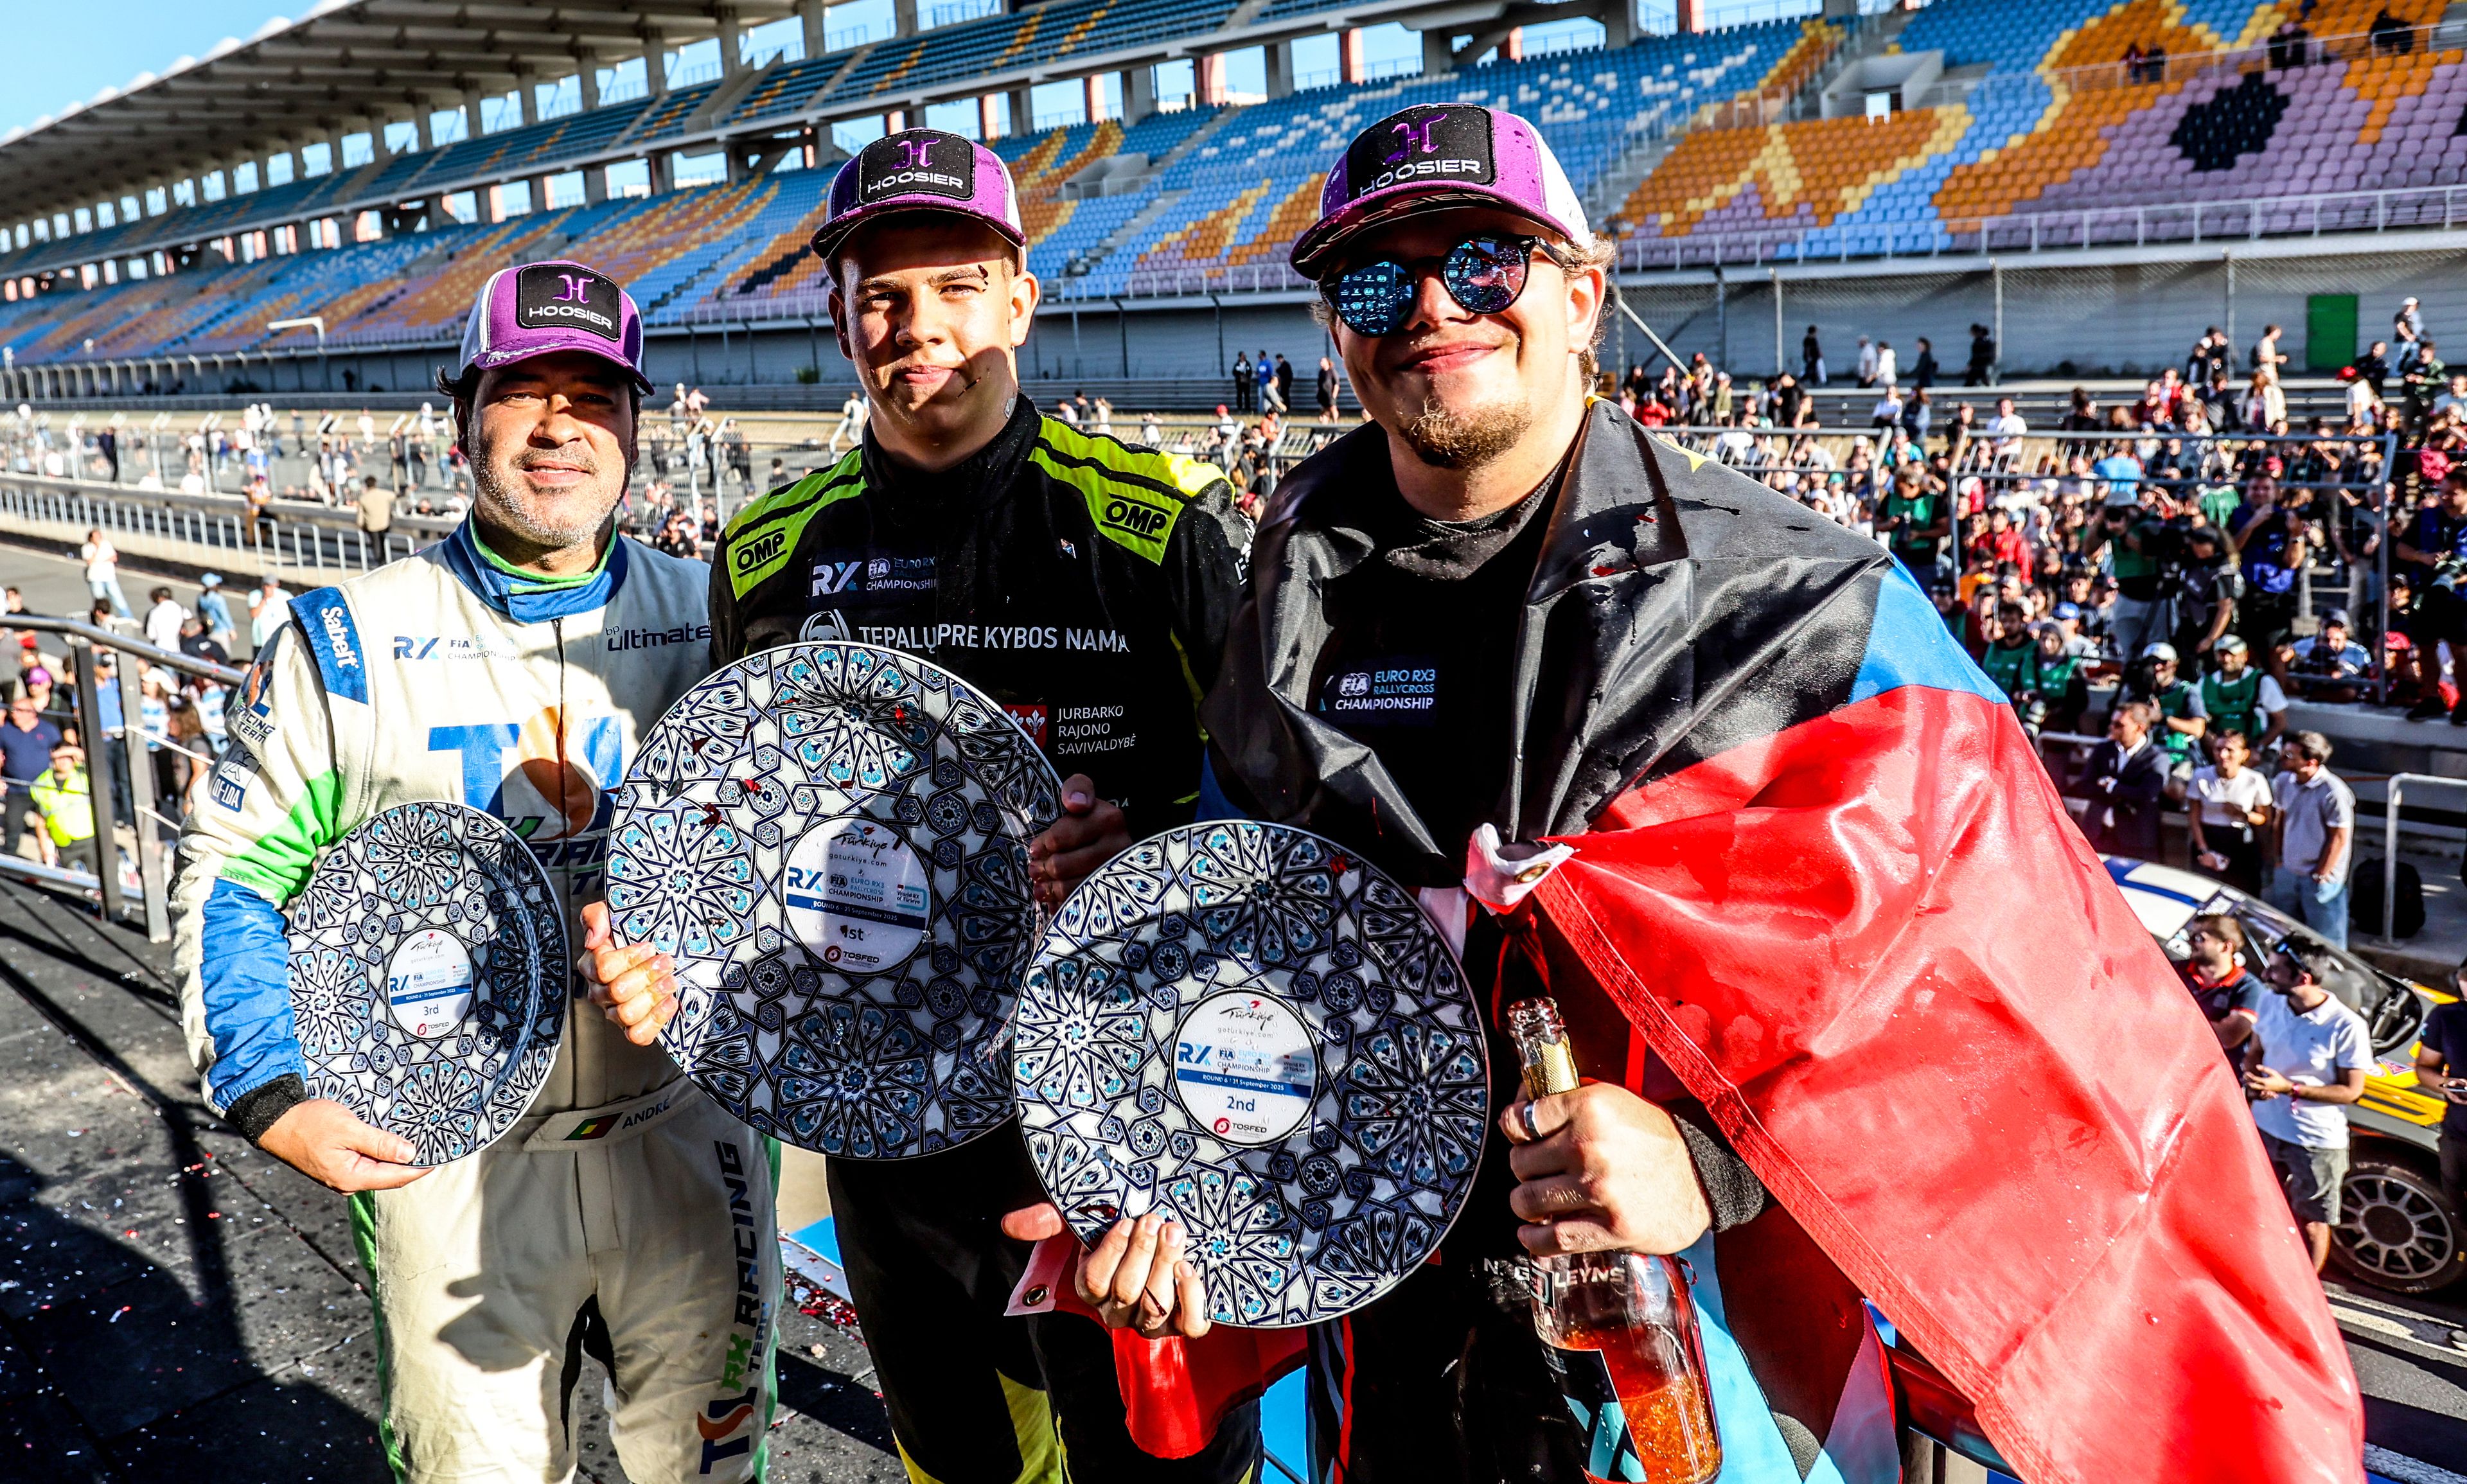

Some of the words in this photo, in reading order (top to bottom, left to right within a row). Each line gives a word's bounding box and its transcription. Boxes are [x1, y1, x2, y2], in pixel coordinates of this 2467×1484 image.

[868, 172, 964, 194] HOOSIER
[1359, 159, 1481, 198] HOOSIER
[529, 306, 613, 330] HOOSIER
[1106, 500, 1167, 535] OMP
[737, 532, 785, 571] OMP
[894, 558, 921, 569] EURO
[321, 606, 359, 669] Sabelt
[606, 626, 620, 636] bp
[607, 623, 711, 651] ultimate
[394, 636, 440, 660] RX
[448, 650, 515, 661] CHAMPIONHIP
[1375, 670, 1410, 683] EURO
[1411, 669, 1436, 682] RX3
[1374, 684, 1435, 694] RALLYCROSS
[1335, 698, 1434, 710] CHAMPIONSHIP
[1057, 705, 1124, 722] JURBARKO
[1058, 723, 1111, 739] RAJONO
[1057, 733, 1136, 755] SAVIVALDYBĖ
[831, 833, 888, 858] Türkiye
[829, 853, 887, 867] goturkiye.com
[851, 877, 870, 886] EURO
[829, 888, 883, 903] CHAMPIONSHIP
[813, 901, 834, 910] ROUND
[852, 907, 883, 919] September
[842, 926, 864, 941] 1st
[843, 951, 880, 964] TOSFED
[423, 1004, 439, 1016] 3rd
[1219, 1007, 1274, 1030] Türkiye
[1217, 1061, 1270, 1073] CHAMPIONSHIP
[1240, 1079, 1269, 1089] September
[1226, 1096, 1255, 1112] 2nd
[1232, 1124, 1267, 1133] TOSFED
[714, 1140, 758, 1328] RACING
